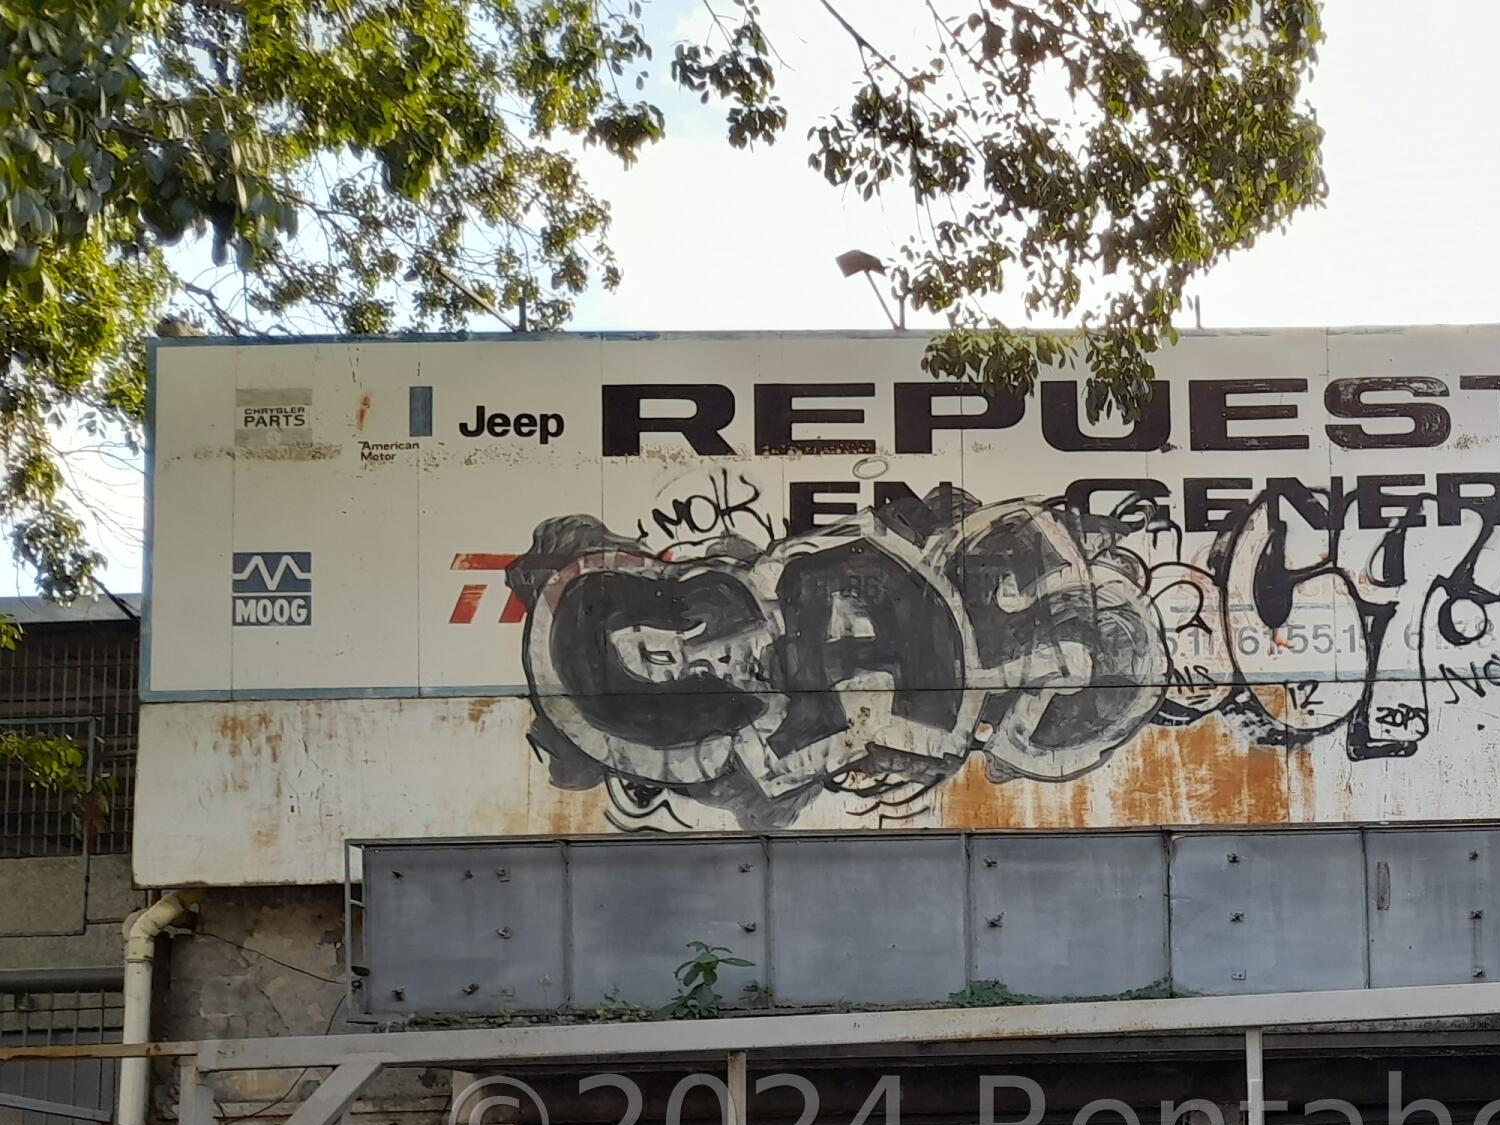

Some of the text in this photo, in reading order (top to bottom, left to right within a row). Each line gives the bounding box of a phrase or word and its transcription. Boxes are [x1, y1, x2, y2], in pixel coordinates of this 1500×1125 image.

[244, 407, 305, 416] CHRYSLER
[244, 415, 306, 428] PARTS
[459, 405, 565, 444] Jeep
[358, 440, 420, 452] American
[789, 480, 955, 537] EN
[235, 598, 308, 624] MOOG
